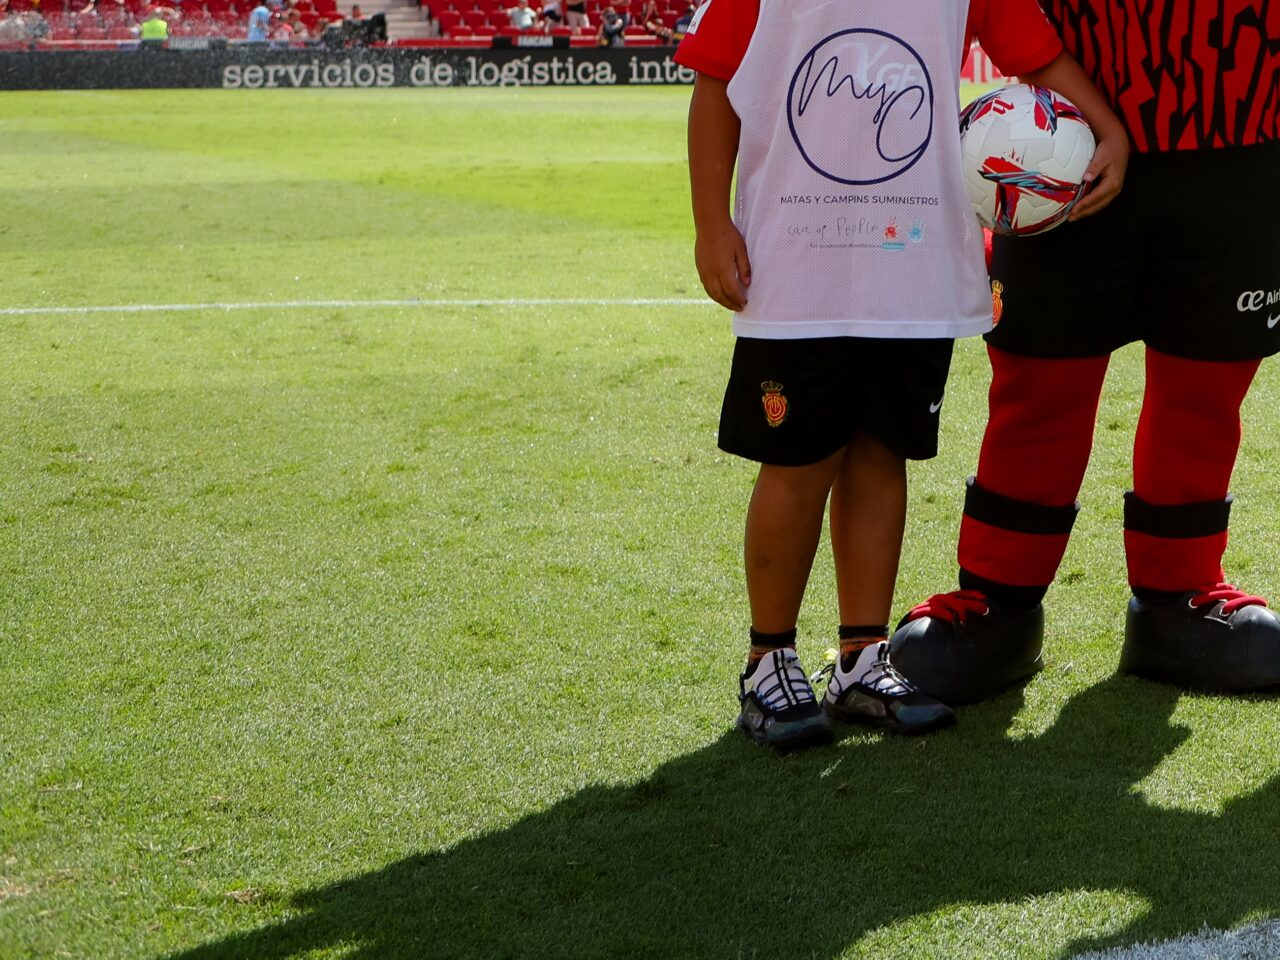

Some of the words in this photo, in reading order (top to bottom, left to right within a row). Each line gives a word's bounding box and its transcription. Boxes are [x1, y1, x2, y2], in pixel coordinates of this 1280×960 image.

[222, 58, 395, 88] servicios
[409, 55, 453, 87] de
[467, 55, 617, 89] logística
[628, 55, 696, 86] inte
[814, 195, 821, 204] Y
[823, 195, 870, 204] CAMPINS
[872, 195, 939, 206] SUMINISTROS
